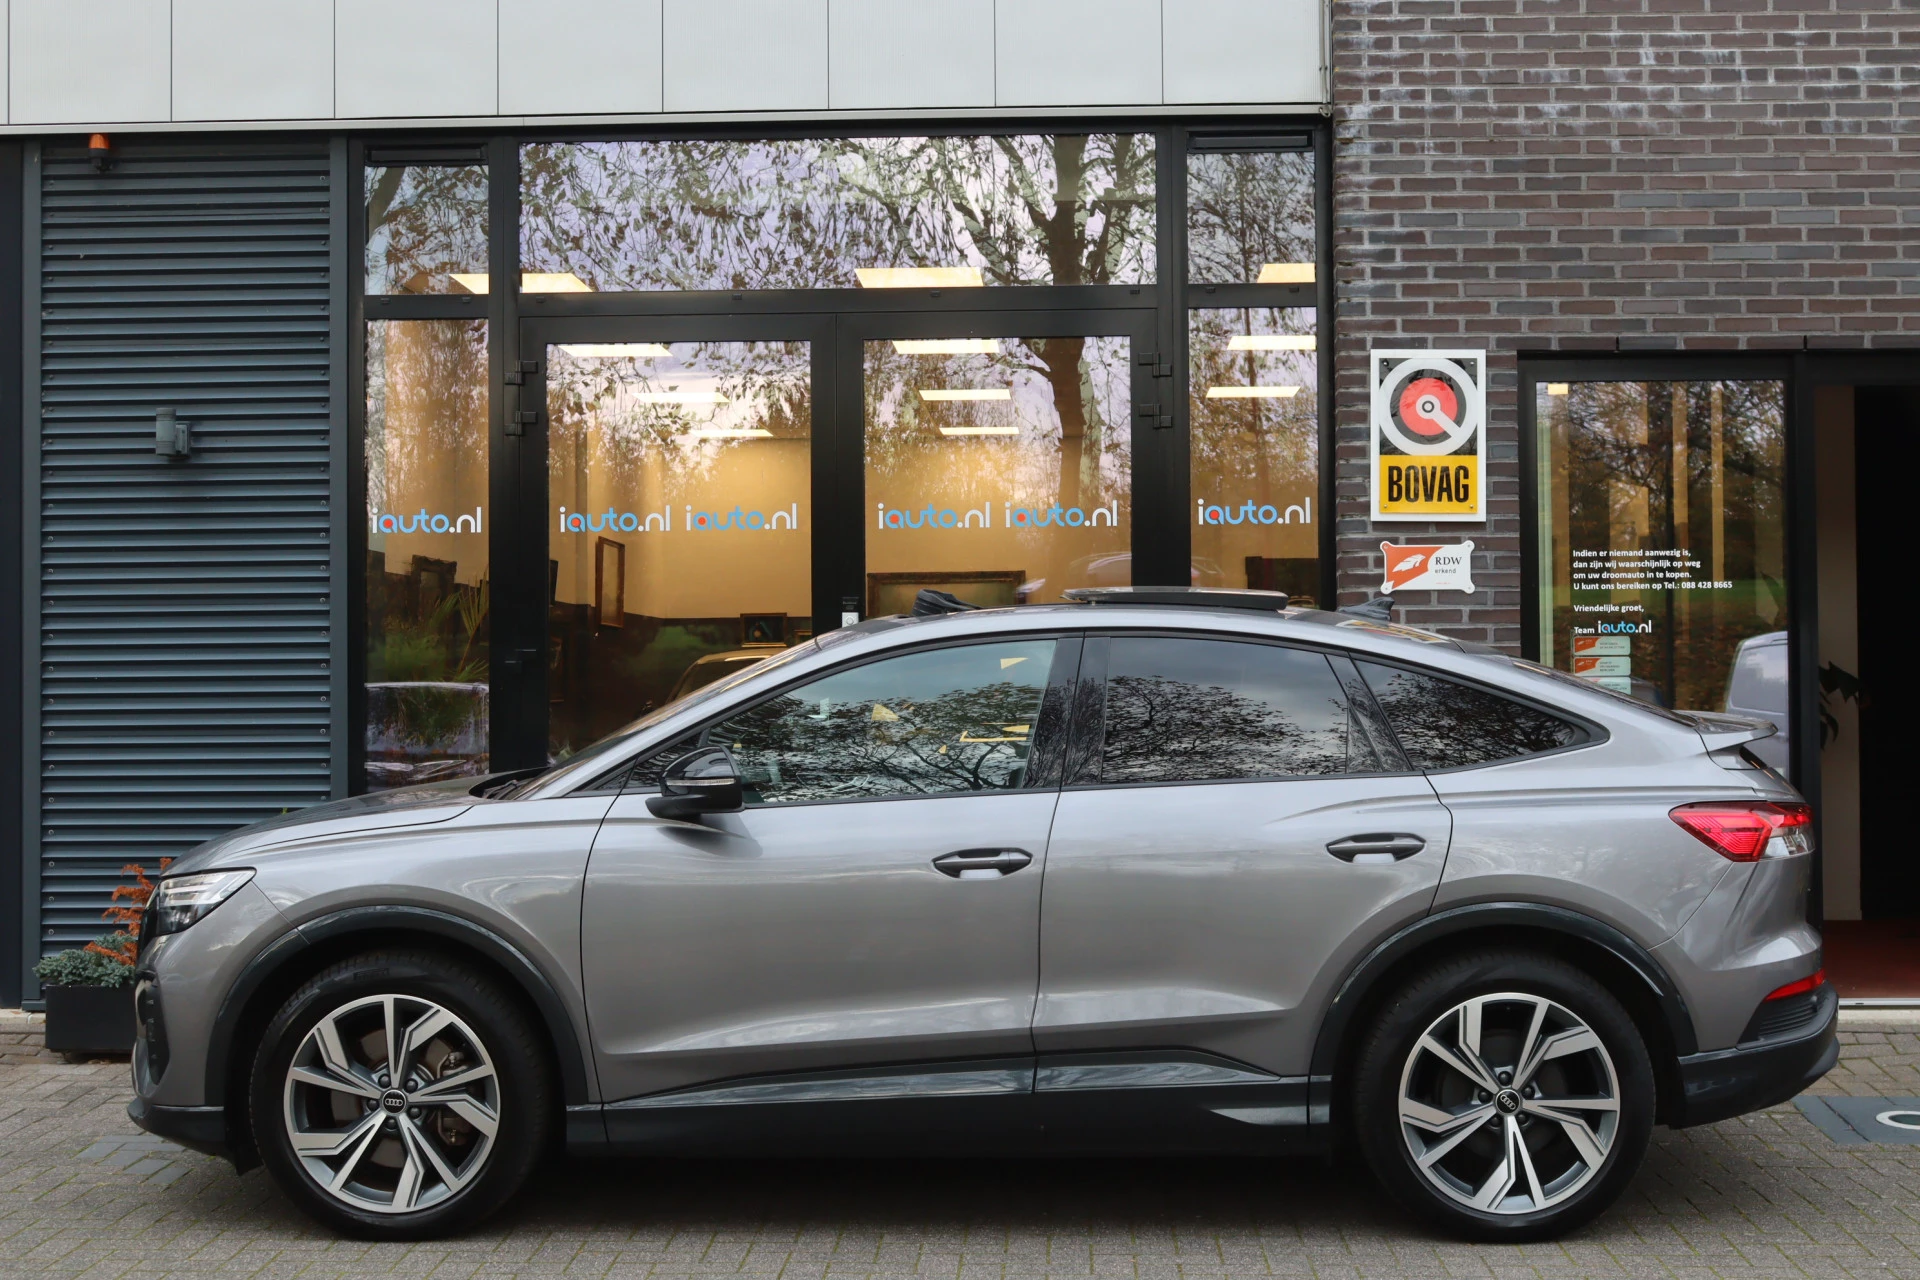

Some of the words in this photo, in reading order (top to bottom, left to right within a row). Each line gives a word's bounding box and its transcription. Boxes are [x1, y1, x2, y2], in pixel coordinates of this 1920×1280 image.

[1387, 465, 1470, 503] BOVAG
[560, 505, 671, 533] iauto.nl
[686, 502, 797, 531] iauto.nl
[878, 501, 990, 530] iauto.nl
[1005, 499, 1118, 528] iauto.nl
[1198, 497, 1310, 525] iauto.nl
[372, 506, 482, 534] iauto.nl
[1572, 549, 1597, 557] Indien
[1609, 549, 1643, 557] niemand
[1644, 549, 1681, 558] aanwezig
[1682, 549, 1691, 557] is,
[1435, 556, 1462, 565] RDW
[1572, 560, 1588, 568] dan
[1589, 560, 1603, 570] zijn
[1605, 560, 1617, 570] wij
[1618, 559, 1671, 569] waarschijnlijk
[1672, 561, 1683, 569] op
[1684, 560, 1701, 569] weg
[1601, 571, 1645, 579] droomauto
[1646, 571, 1654, 579] in
[1665, 570, 1692, 580] kopen.
[1573, 582, 1580, 590] U
[1581, 582, 1599, 590] kunt
[1616, 582, 1650, 590] bereiken
[1651, 582, 1662, 591] op
[1664, 581, 1680, 589] Tel.:
[1681, 581, 1696, 589] 088
[1697, 581, 1712, 589] 428
[1713, 581, 1733, 589] 8665
[1573, 604, 1620, 613] Vriendelijke
[1621, 604, 1645, 613] groet,
[1573, 626, 1595, 634] Team
[1597, 619, 1652, 634] iauto.nl
